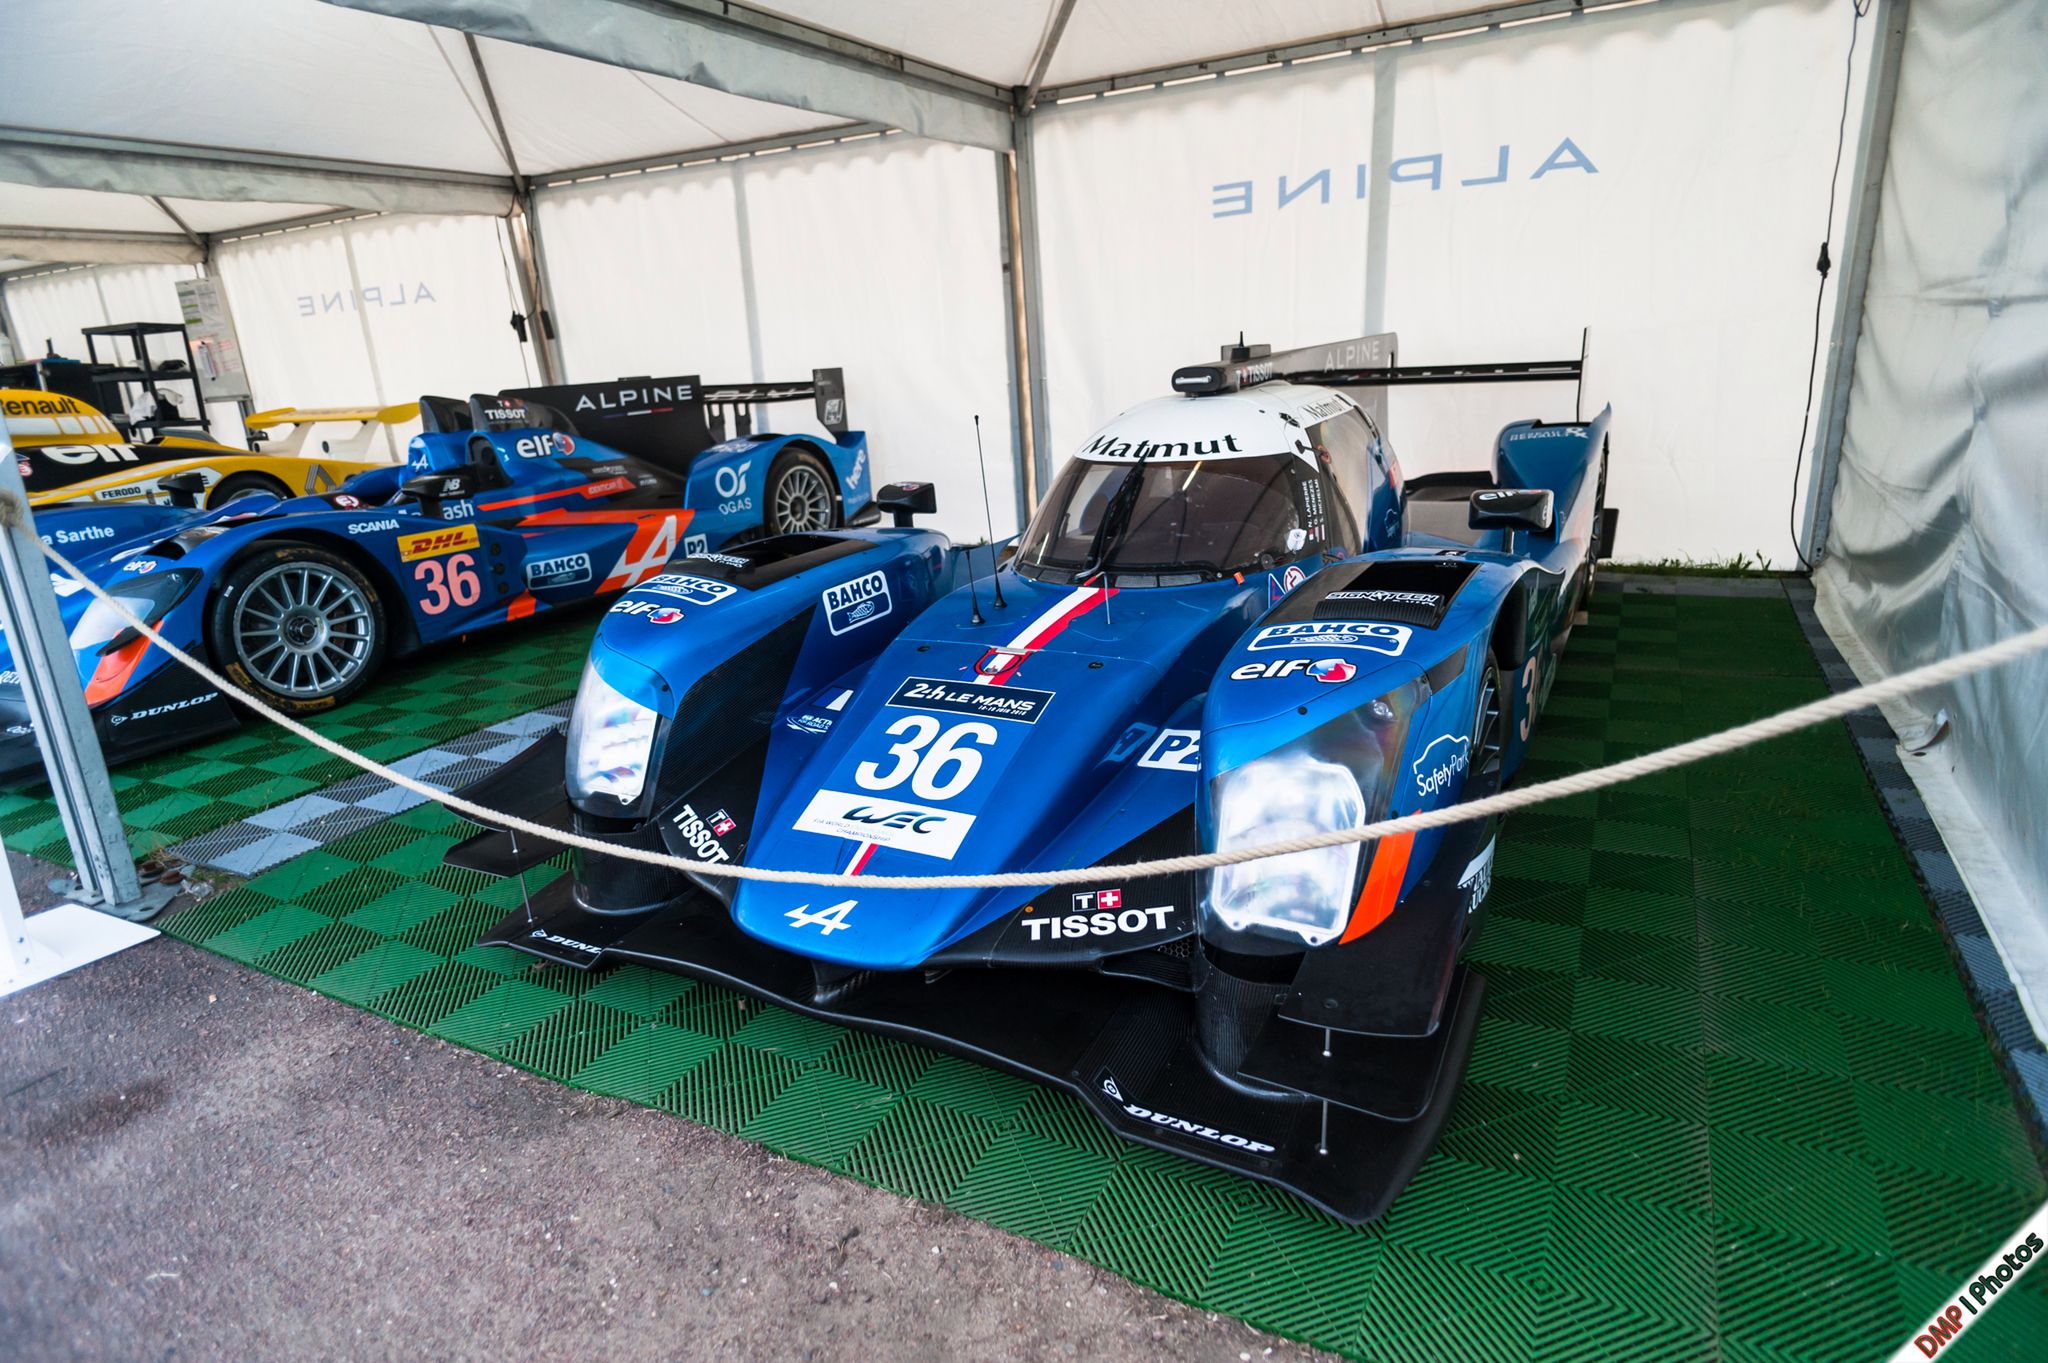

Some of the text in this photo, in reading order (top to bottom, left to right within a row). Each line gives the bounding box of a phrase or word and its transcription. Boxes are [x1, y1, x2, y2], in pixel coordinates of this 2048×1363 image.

[1324, 340, 1380, 373] ALPINE
[1248, 362, 1273, 384] TISSOT
[0, 397, 80, 415] enault
[575, 384, 693, 412] ALPINE
[1302, 397, 1347, 419] Matmut
[484, 408, 526, 420] TISSOT
[516, 434, 554, 459] elf
[1083, 434, 1244, 458] Matmut
[101, 486, 141, 499] FERODO
[1302, 481, 1312, 518] LAPIERRE
[1308, 479, 1318, 515] MENEZES
[1314, 479, 1323, 514] RICHELMI
[40, 526, 115, 546] a Sarthe
[348, 519, 400, 534] SCANIA
[411, 532, 468, 554] DHL
[530, 556, 587, 577] BAHCO
[414, 553, 481, 616] 36
[652, 575, 728, 594] BAHCO
[827, 575, 883, 610] BAHCO
[609, 600, 660, 615] elf
[1267, 623, 1400, 637] BAHCO
[1230, 659, 1311, 680] elf
[130, 692, 218, 721] DUNLOP
[945, 692, 974, 703] LE
[971, 695, 1036, 711] MANS
[855, 715, 998, 801] 36
[842, 806, 947, 834] WEC
[673, 804, 730, 864] TISSOT
[1021, 905, 1174, 941] TISSOT
[545, 935, 602, 953] DUNL
[1123, 1103, 1276, 1153] DUNLOP
